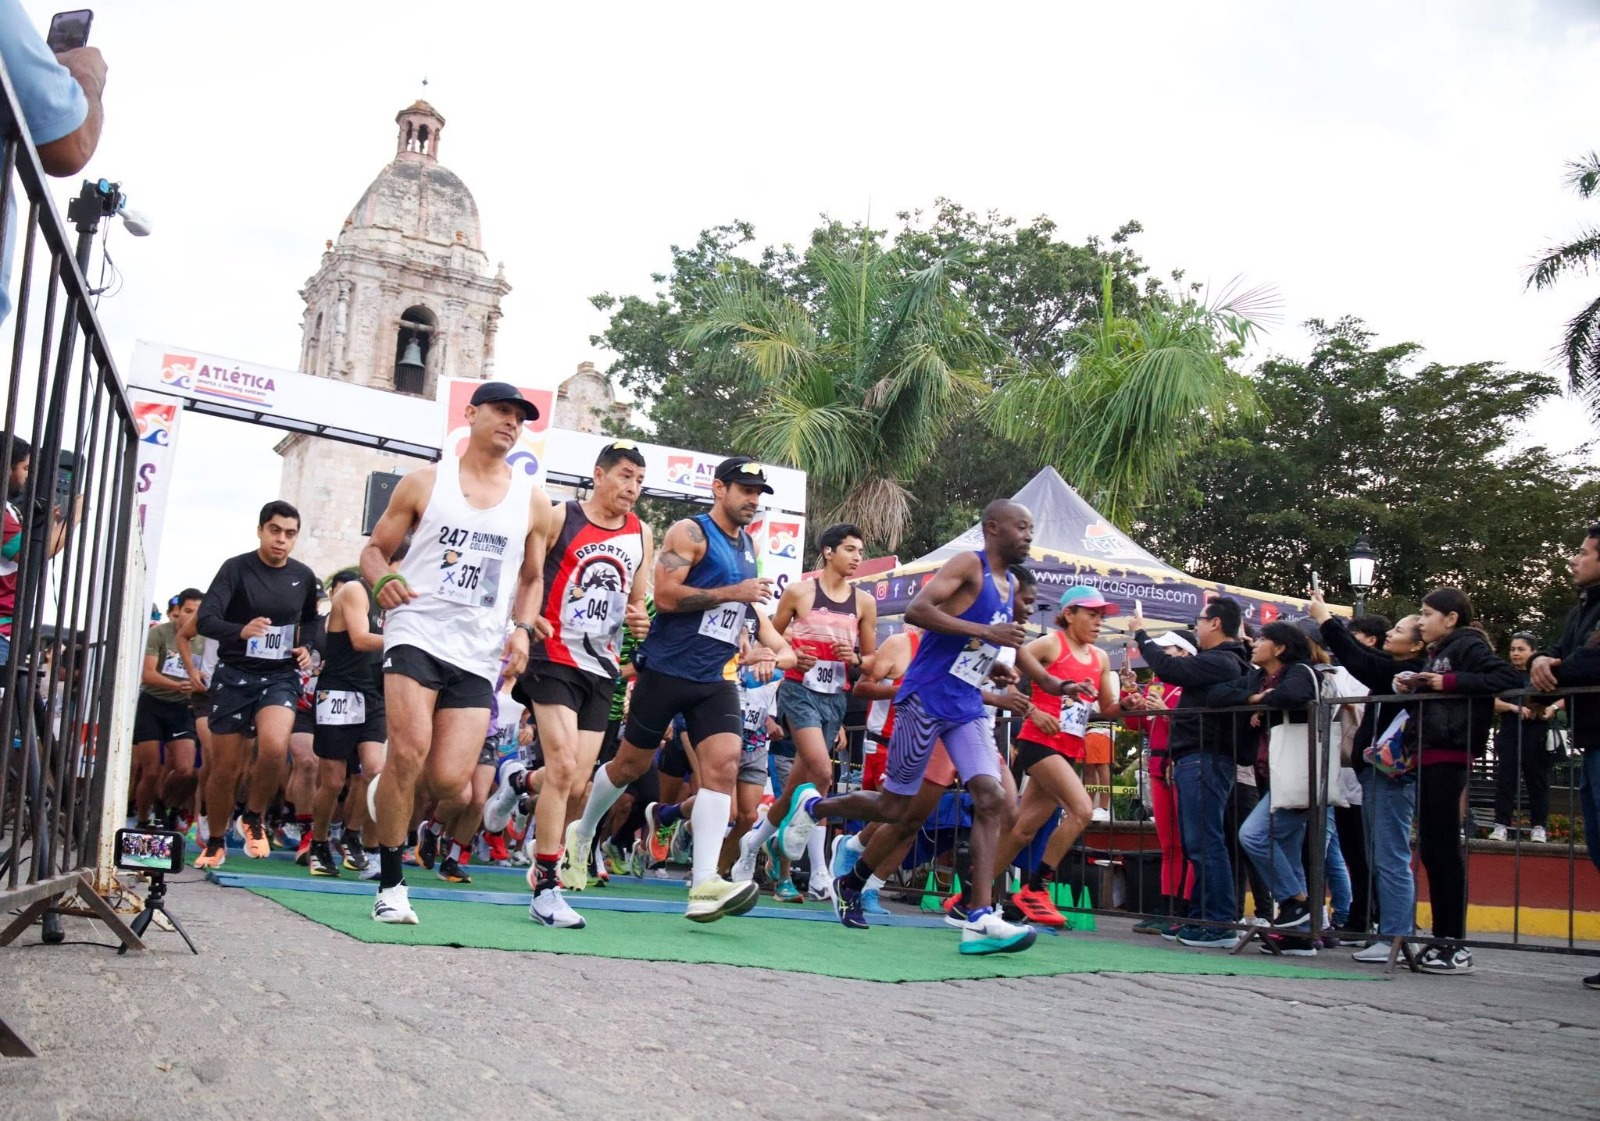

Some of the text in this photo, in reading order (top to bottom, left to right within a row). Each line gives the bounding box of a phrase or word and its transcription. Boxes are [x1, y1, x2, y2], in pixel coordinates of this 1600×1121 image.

[439, 526, 469, 547] 247
[471, 531, 508, 548] RUNNING
[469, 542, 505, 556] COLLECTIVE
[457, 564, 481, 590] 376
[1030, 568, 1197, 605] ww.atleticasports.com
[587, 598, 608, 621] 049
[720, 608, 738, 630] 127
[265, 633, 281, 649] 100
[816, 667, 833, 684] 309
[331, 698, 348, 715] 202
